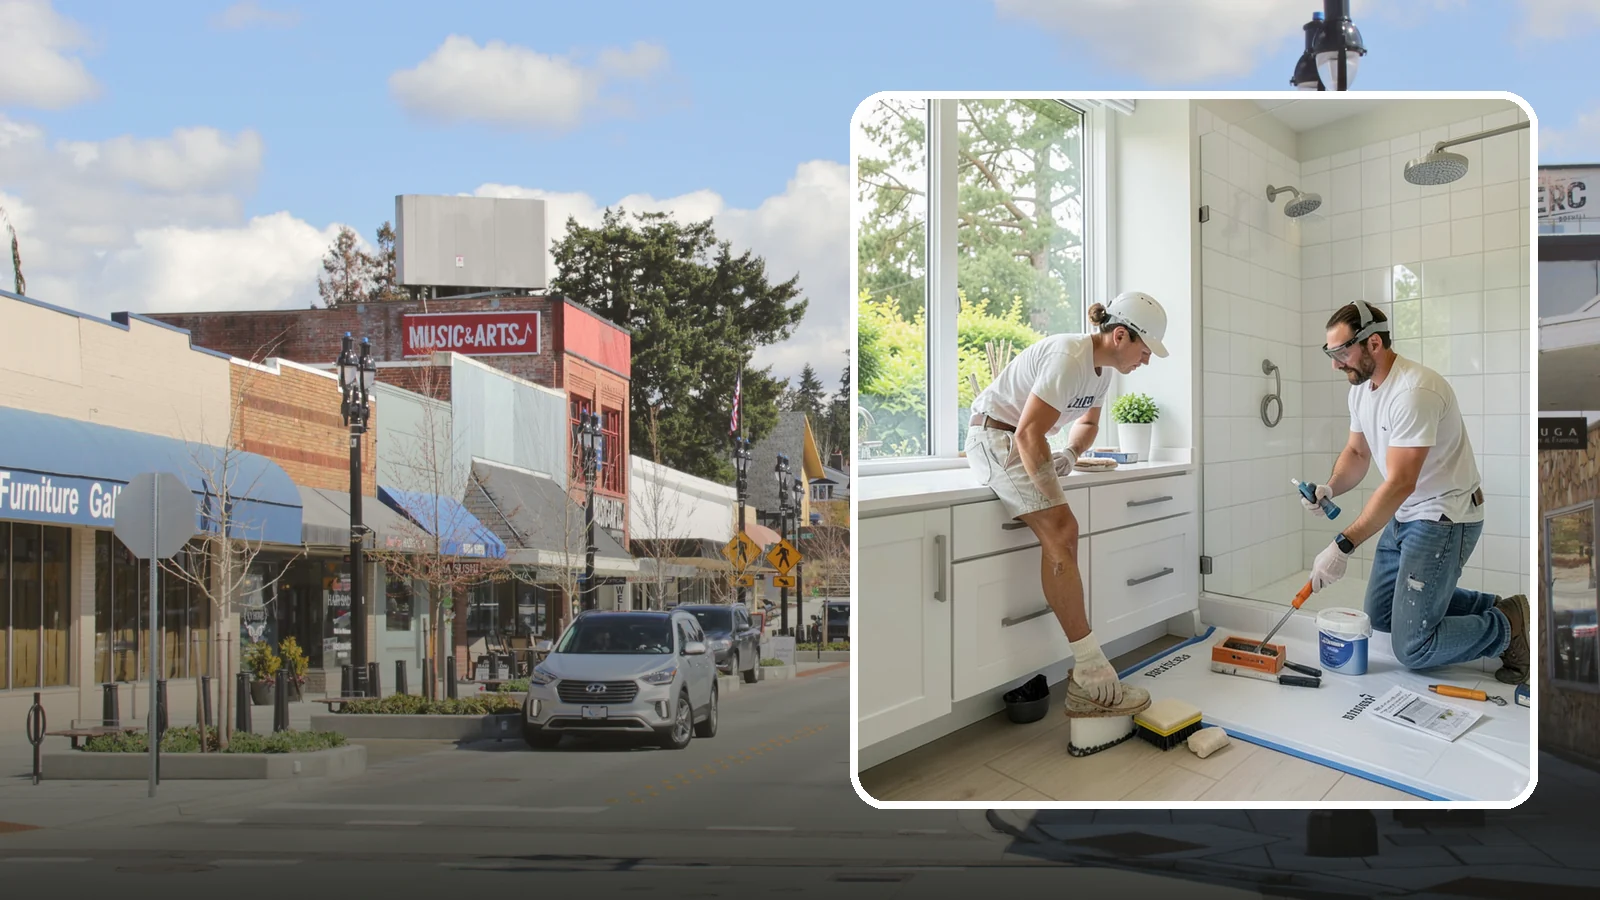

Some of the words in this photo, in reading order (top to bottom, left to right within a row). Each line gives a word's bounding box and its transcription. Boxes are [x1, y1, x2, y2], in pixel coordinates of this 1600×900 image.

[409, 323, 519, 348] MUSIC&ARTS
[1540, 428, 1577, 436] UGA
[0, 472, 79, 515] Furniture
[89, 483, 122, 519] Gal
[453, 563, 480, 574] SUSHI
